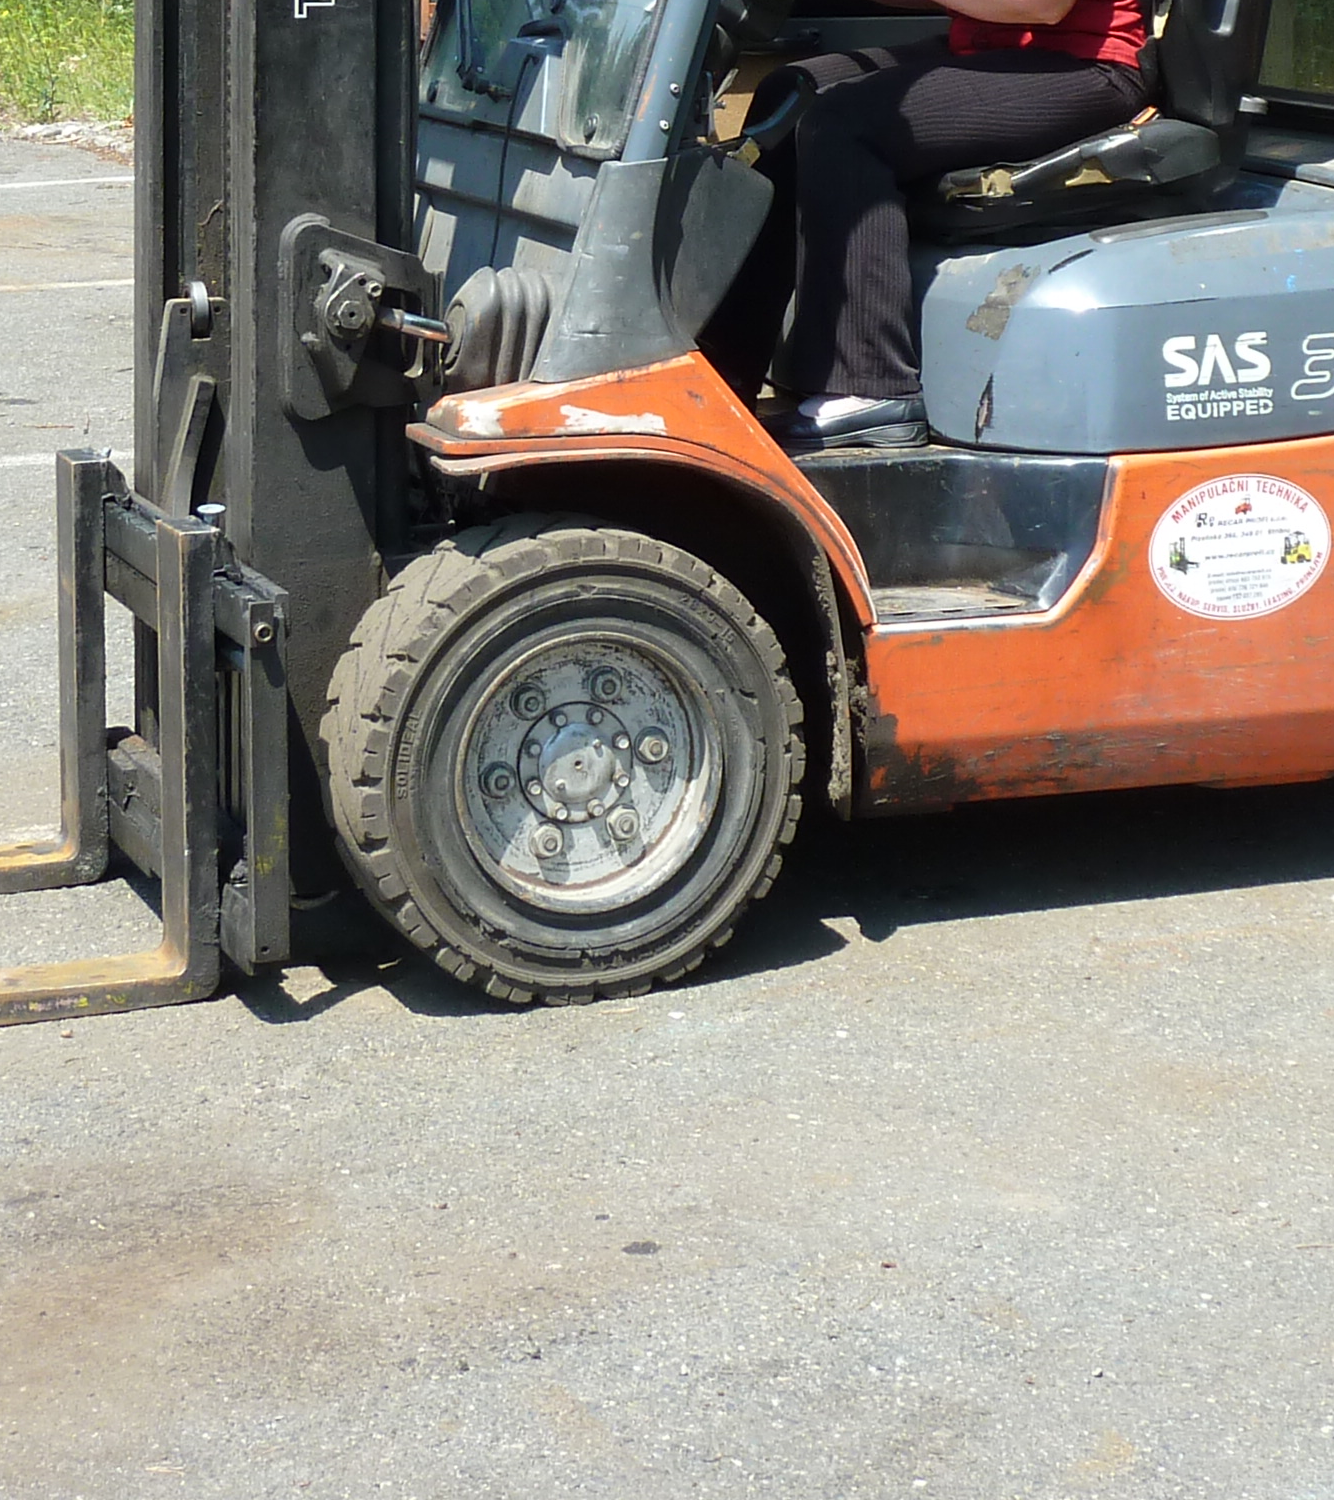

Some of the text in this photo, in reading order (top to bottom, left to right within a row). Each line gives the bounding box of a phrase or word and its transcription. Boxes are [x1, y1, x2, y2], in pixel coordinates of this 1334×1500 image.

[1162, 331, 1271, 388] SAS
[1166, 386, 1274, 404] System of Active Stability
[1167, 399, 1274, 421] EQUIPPED
[1171, 479, 1308, 524] MANIPULAČNÍ TECHNIKA
[1218, 518, 1243, 527] RECAR
